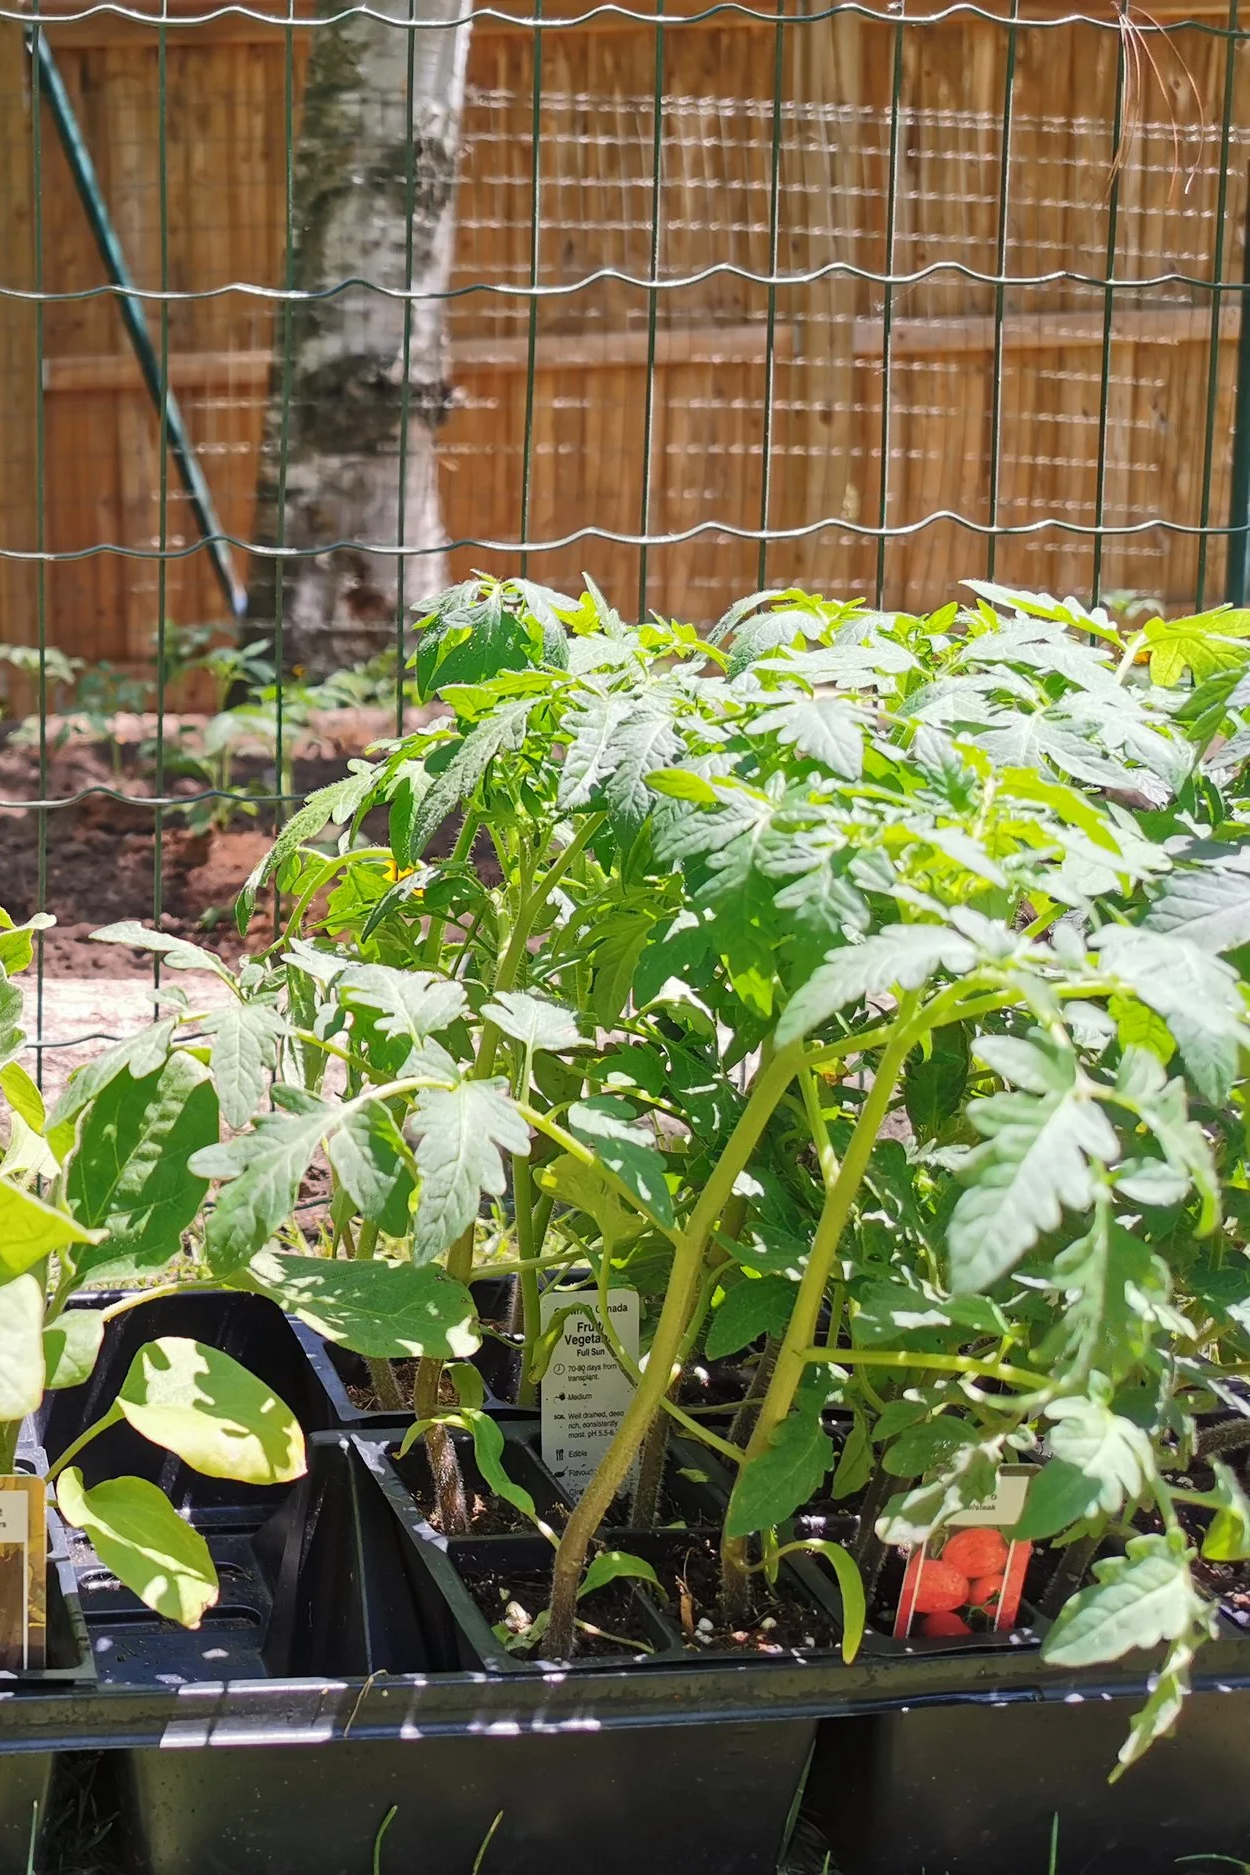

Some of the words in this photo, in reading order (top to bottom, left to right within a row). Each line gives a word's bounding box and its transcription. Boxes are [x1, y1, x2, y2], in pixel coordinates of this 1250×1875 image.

[577, 1349, 590, 1357] Full
[591, 1348, 605, 1356] Sun
[586, 1364, 601, 1372] days
[567, 1393, 593, 1401] Medium
[568, 1412, 582, 1420] Well
[587, 1429, 597, 1438] pH
[568, 1450, 588, 1458] Edible
